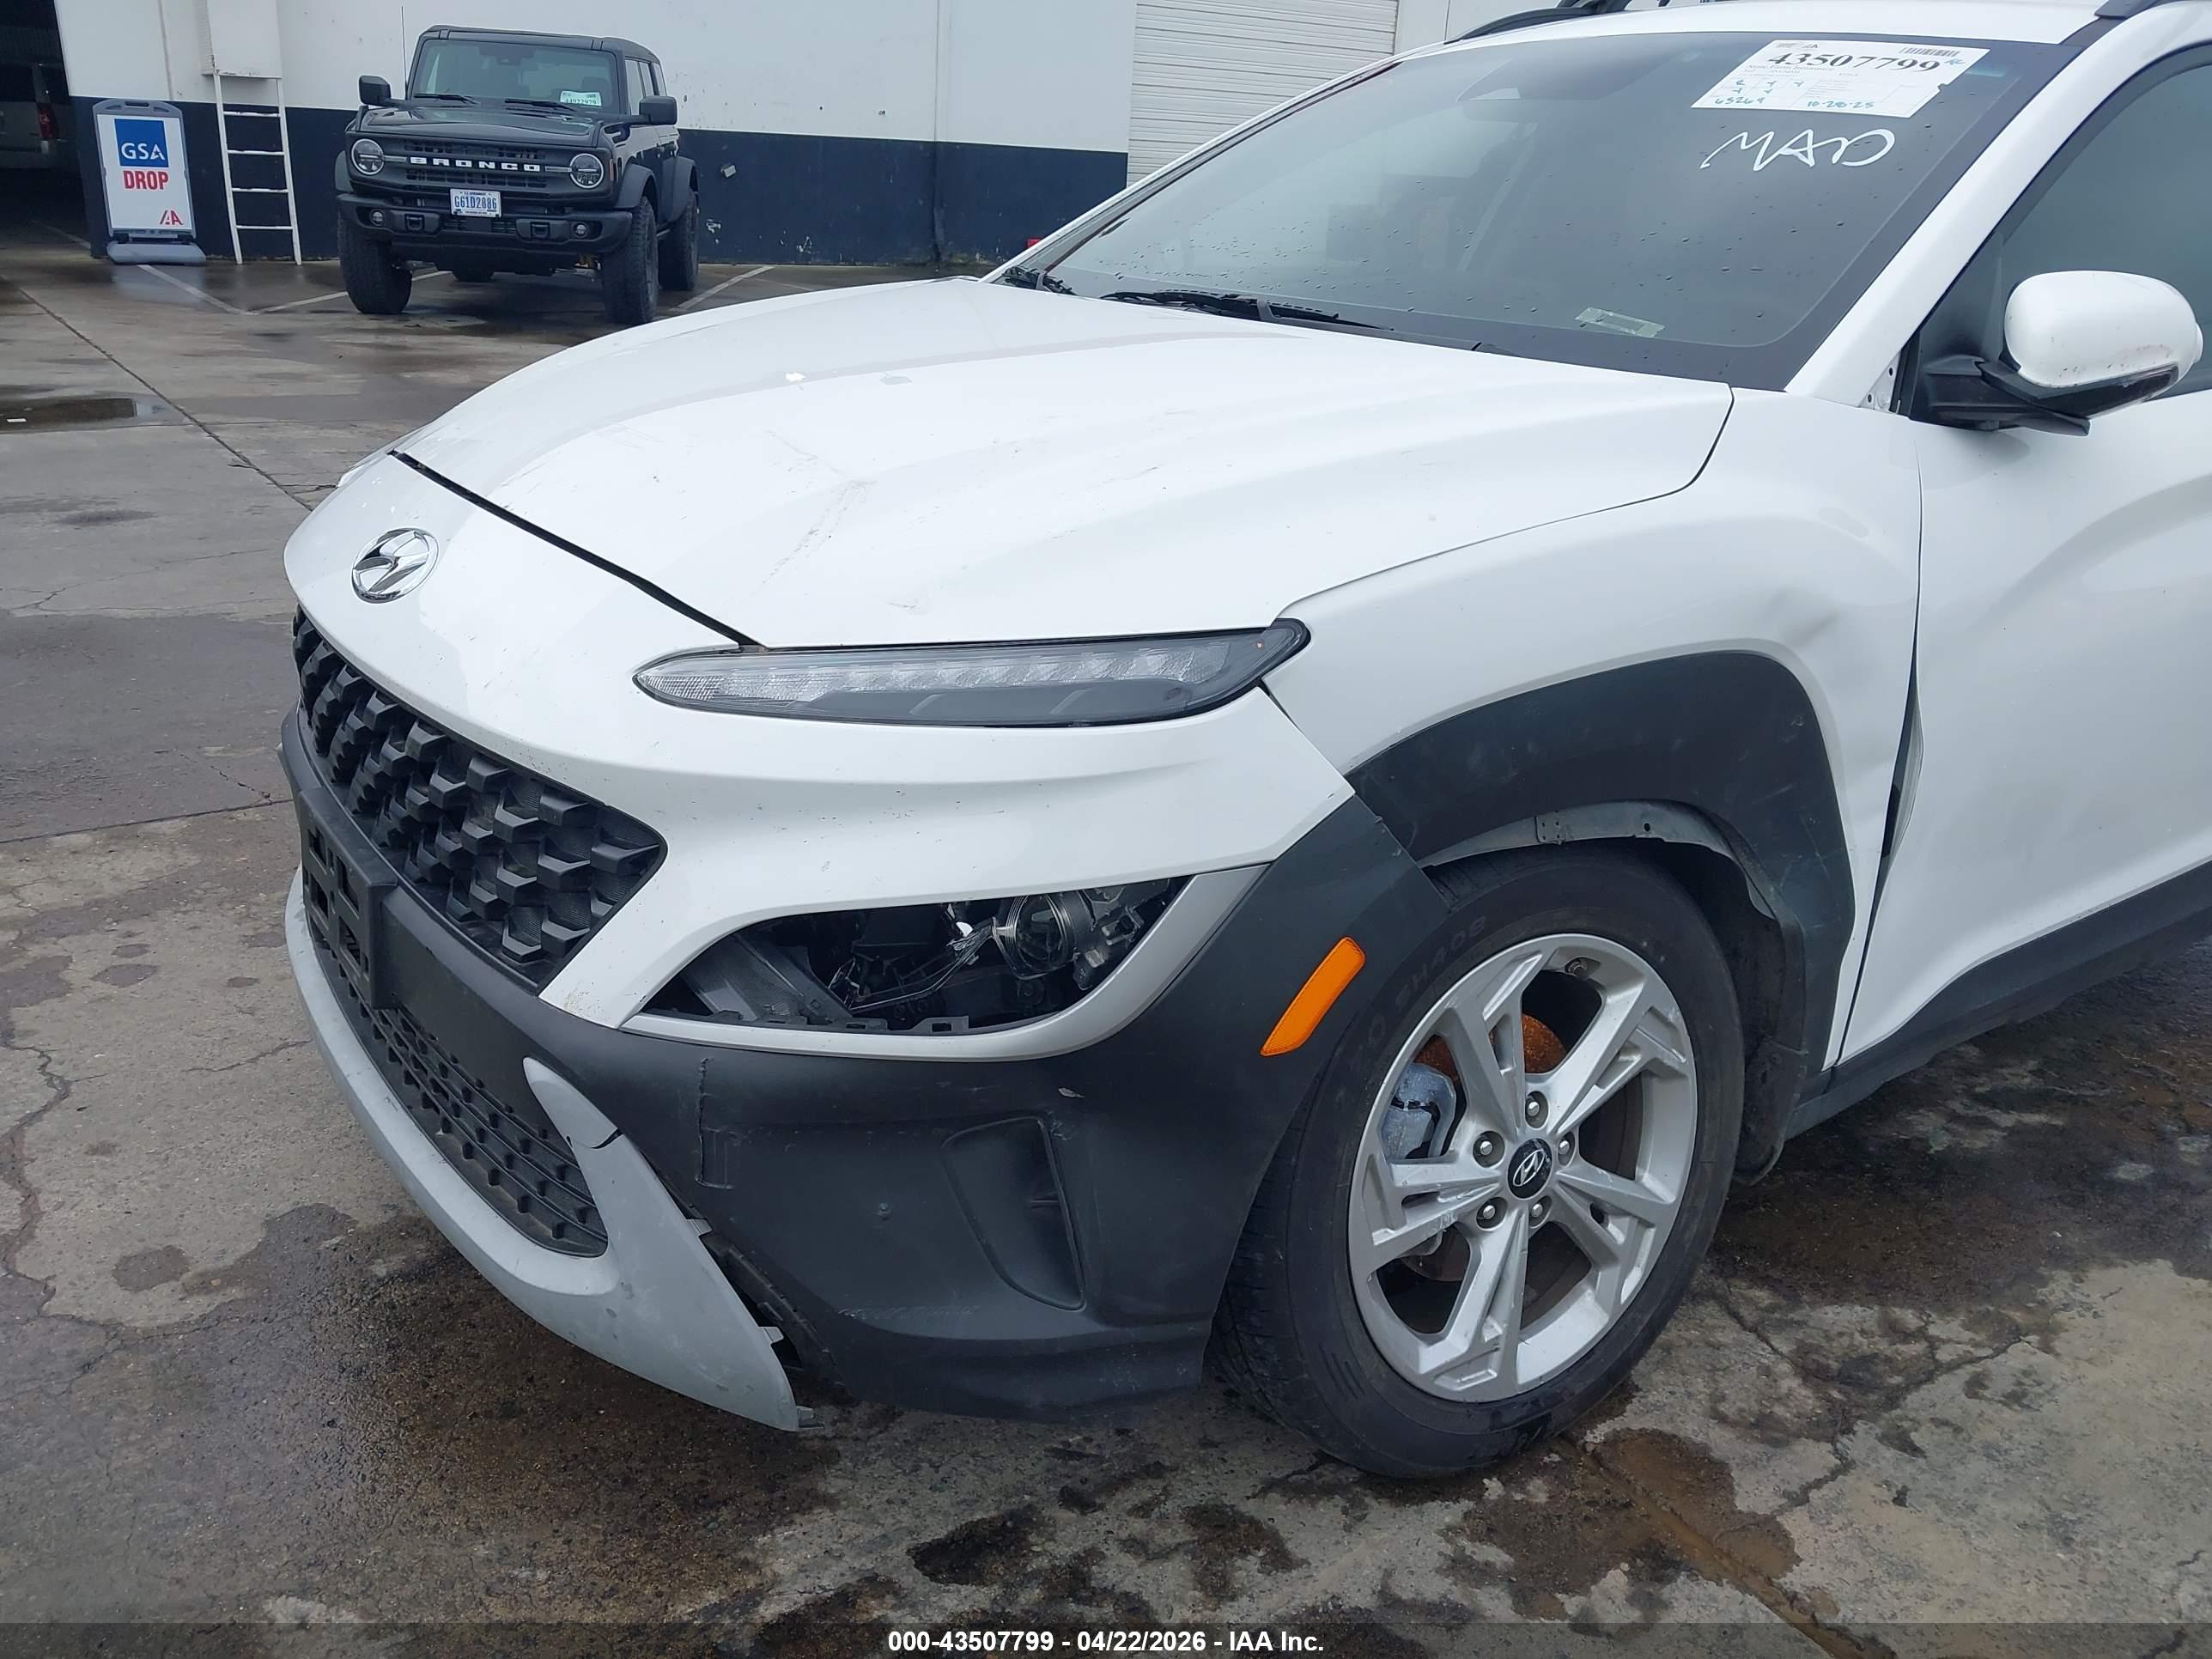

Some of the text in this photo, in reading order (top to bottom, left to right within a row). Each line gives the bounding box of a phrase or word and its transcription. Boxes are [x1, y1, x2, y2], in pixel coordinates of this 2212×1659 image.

[1767, 52, 1941, 73] 43507799
[121, 143, 165, 160] GSA
[410, 156, 541, 173] BRONCO
[124, 170, 168, 190] DROP
